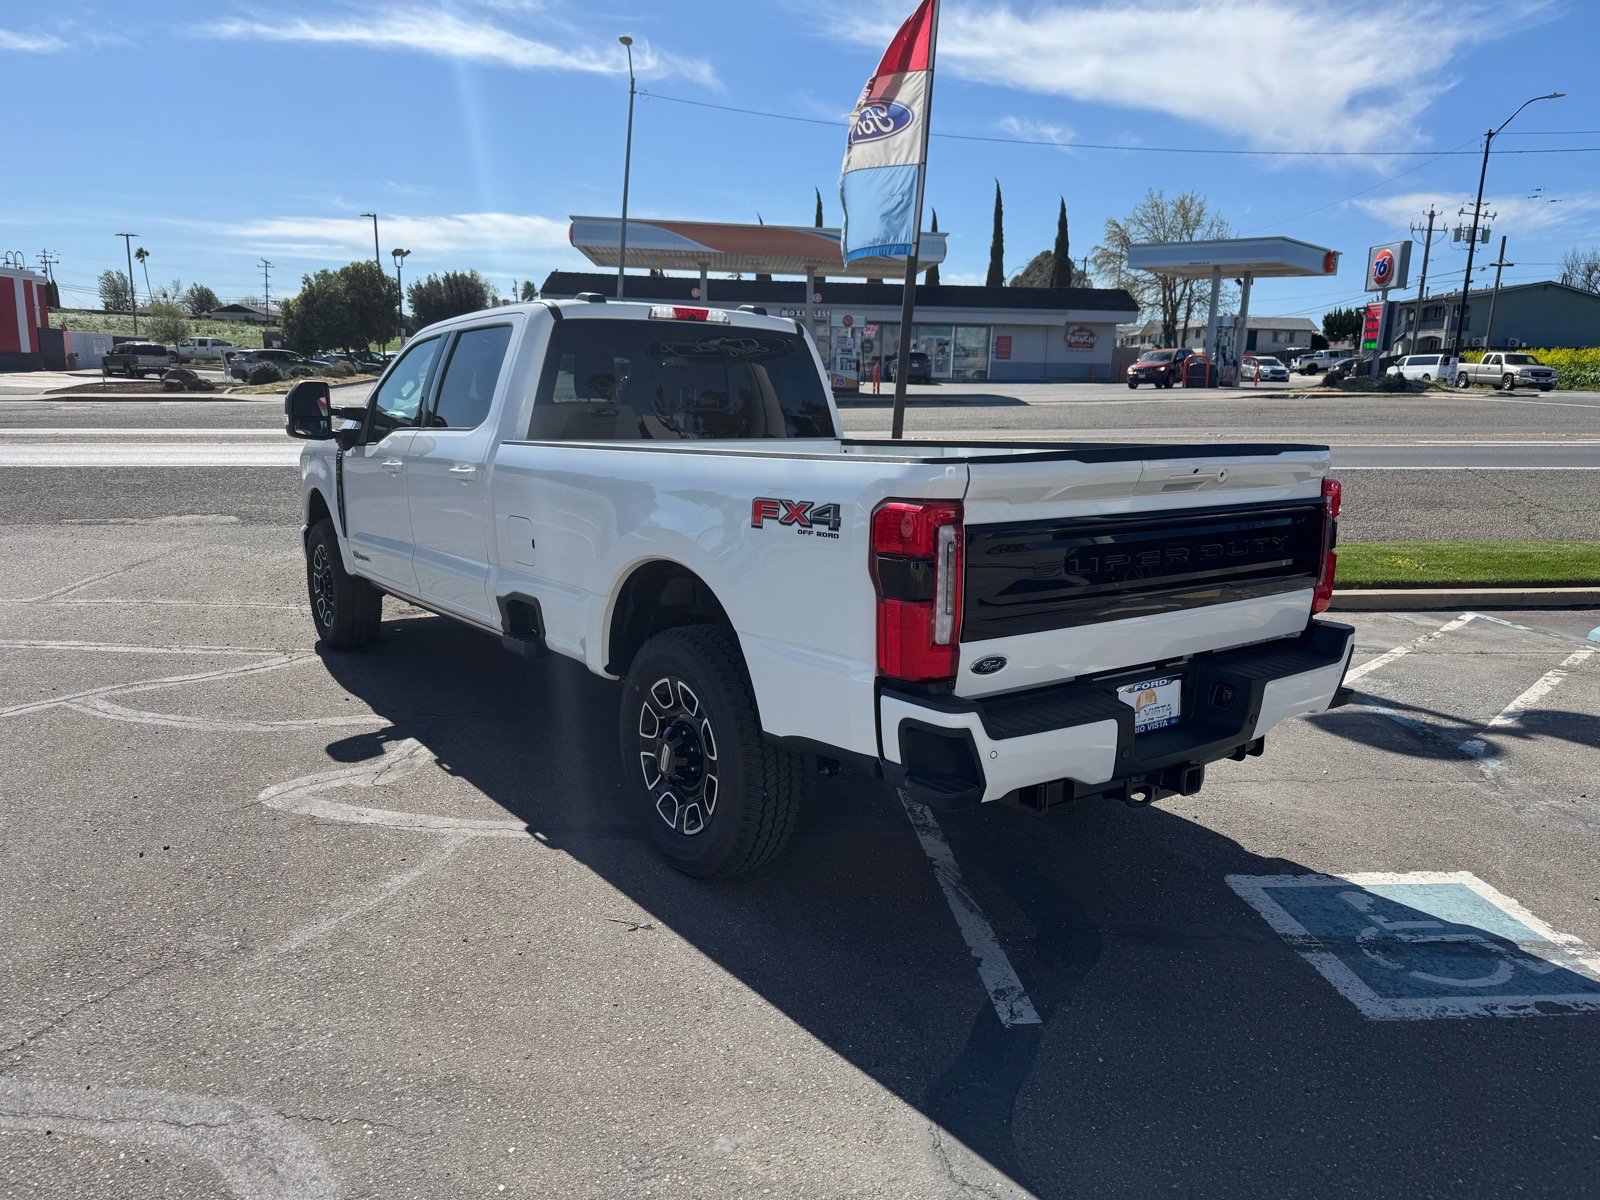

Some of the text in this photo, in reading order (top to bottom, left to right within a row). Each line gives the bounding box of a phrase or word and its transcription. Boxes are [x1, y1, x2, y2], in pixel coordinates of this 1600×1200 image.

[1373, 257, 1389, 278] 76
[751, 497, 841, 532] FX4
[797, 528, 840, 539] OFF ROAD
[1031, 534, 1291, 579] SUPER DUTY
[1134, 679, 1168, 691] FORD
[1147, 719, 1168, 730] VISTA
